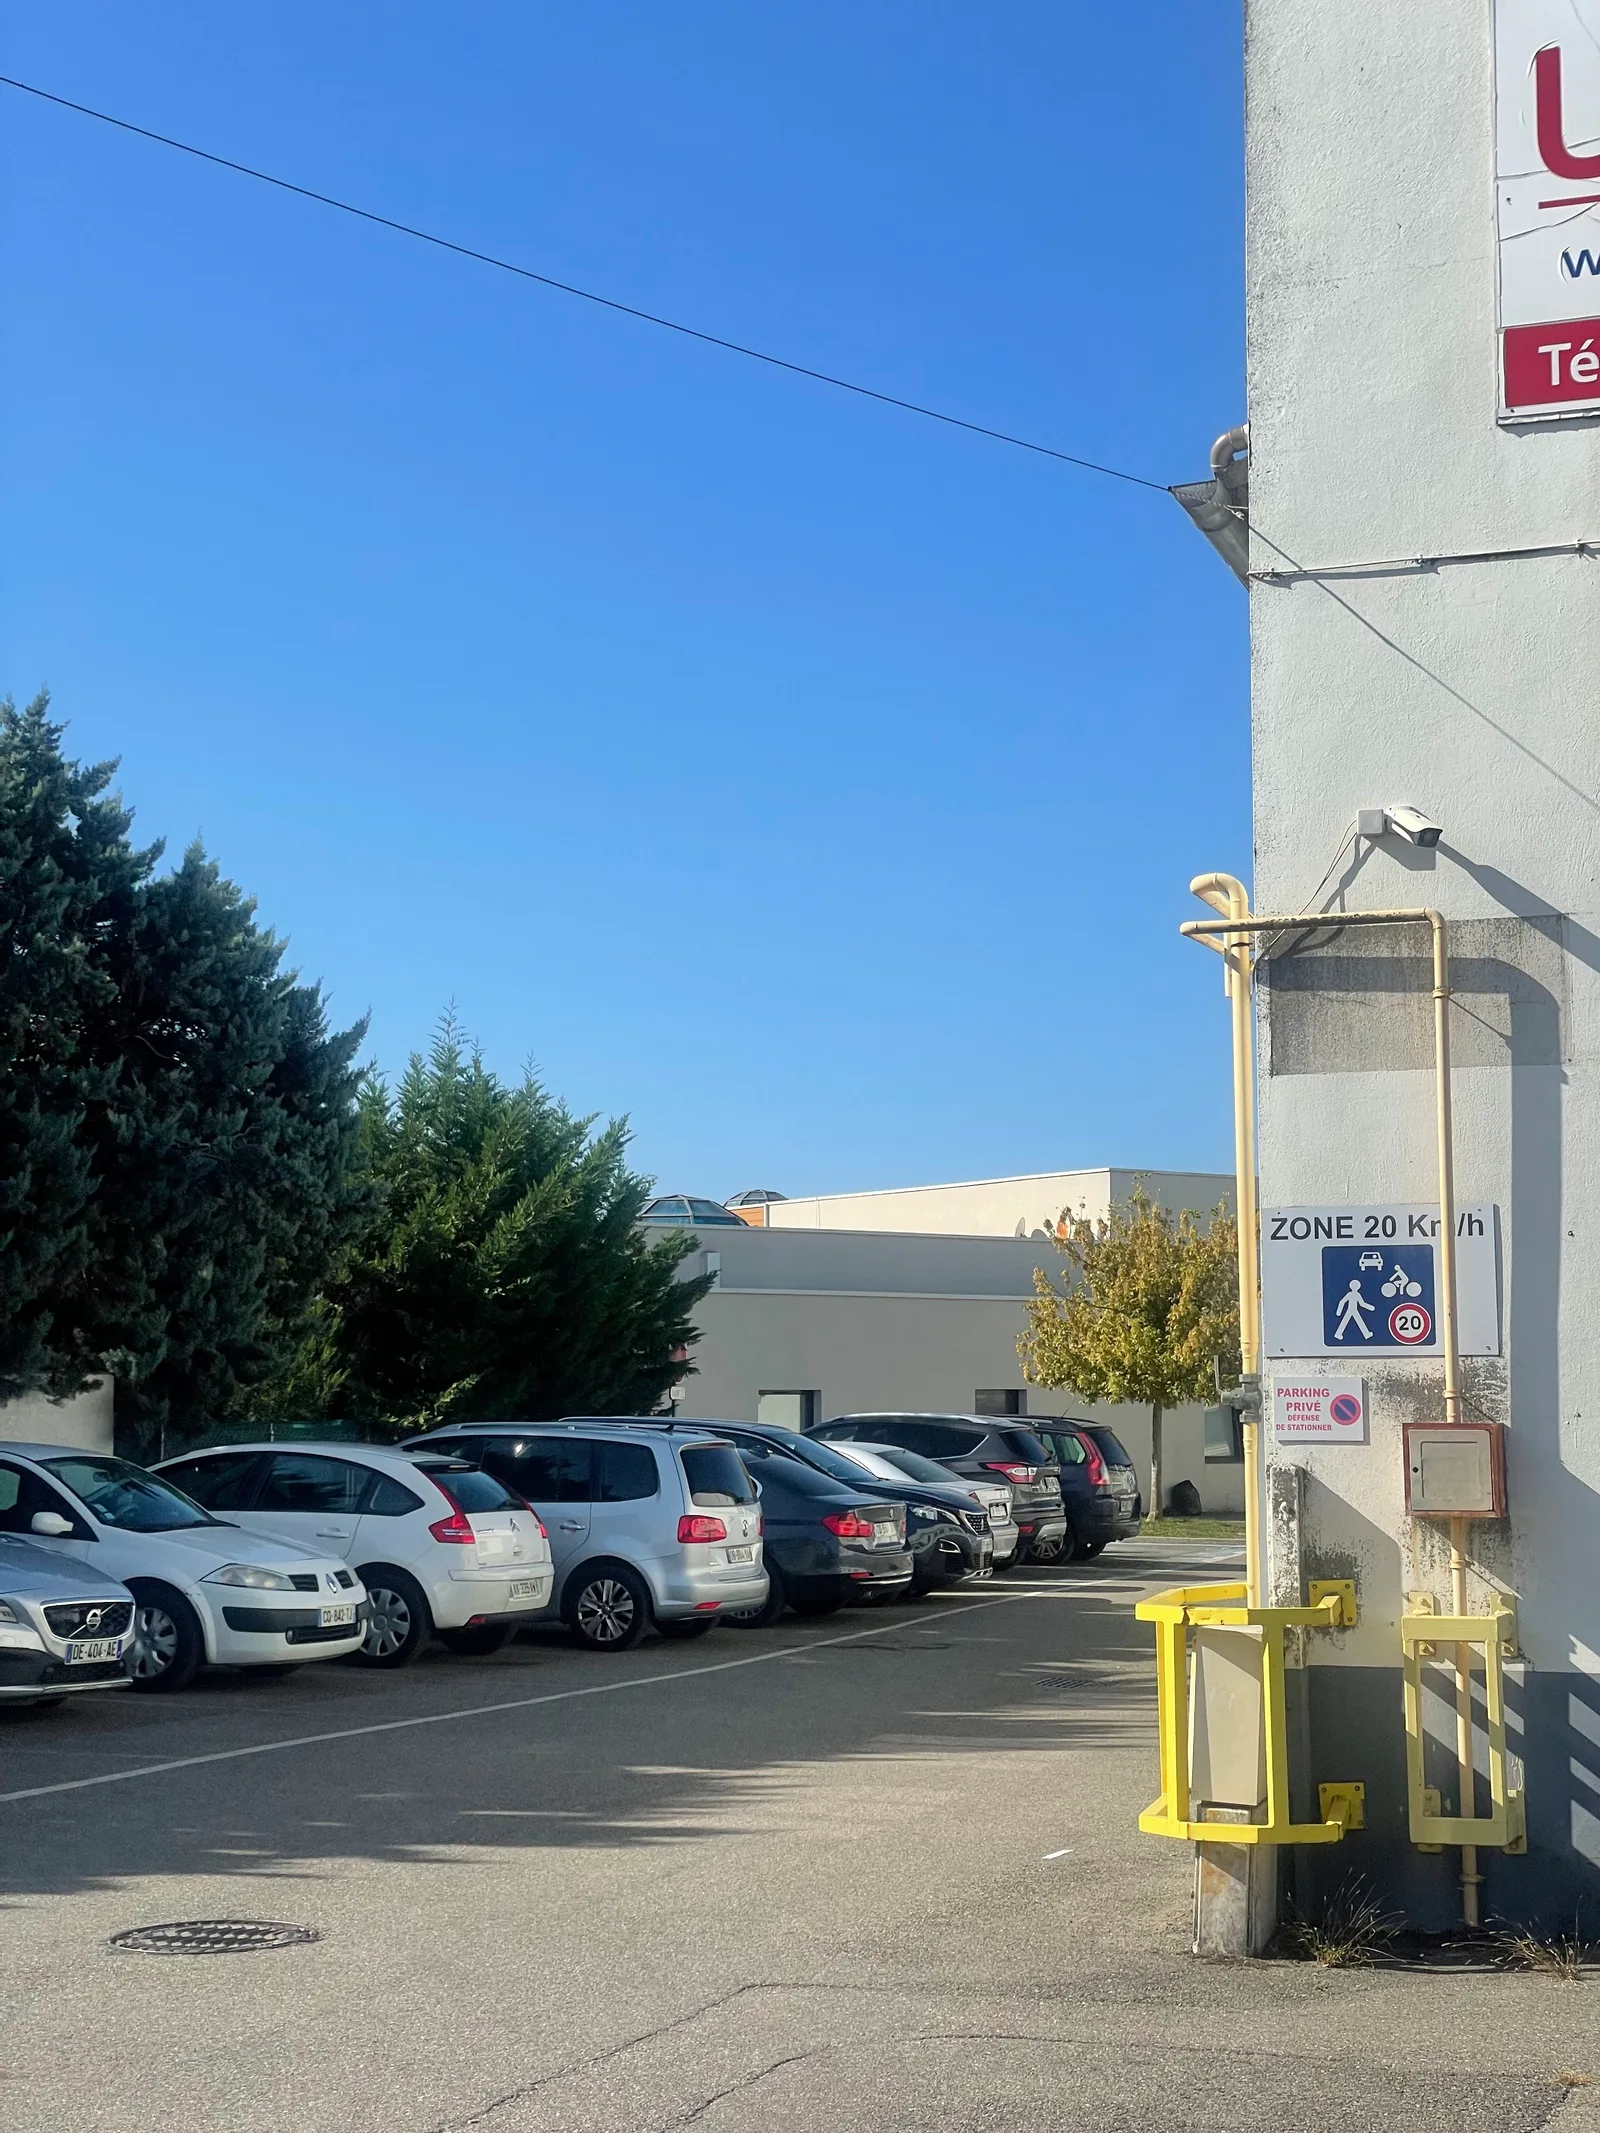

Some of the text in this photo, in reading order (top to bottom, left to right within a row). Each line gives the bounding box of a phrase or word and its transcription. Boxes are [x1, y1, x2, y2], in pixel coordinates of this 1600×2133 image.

[1271, 1216, 1354, 1240] ZONE
[1364, 1215, 1397, 1238] 20
[1398, 1315, 1422, 1331] 20
[1277, 1387, 1330, 1398] PARKING
[1286, 1400, 1321, 1412] PRIVÉ
[1276, 1423, 1285, 1431] DE
